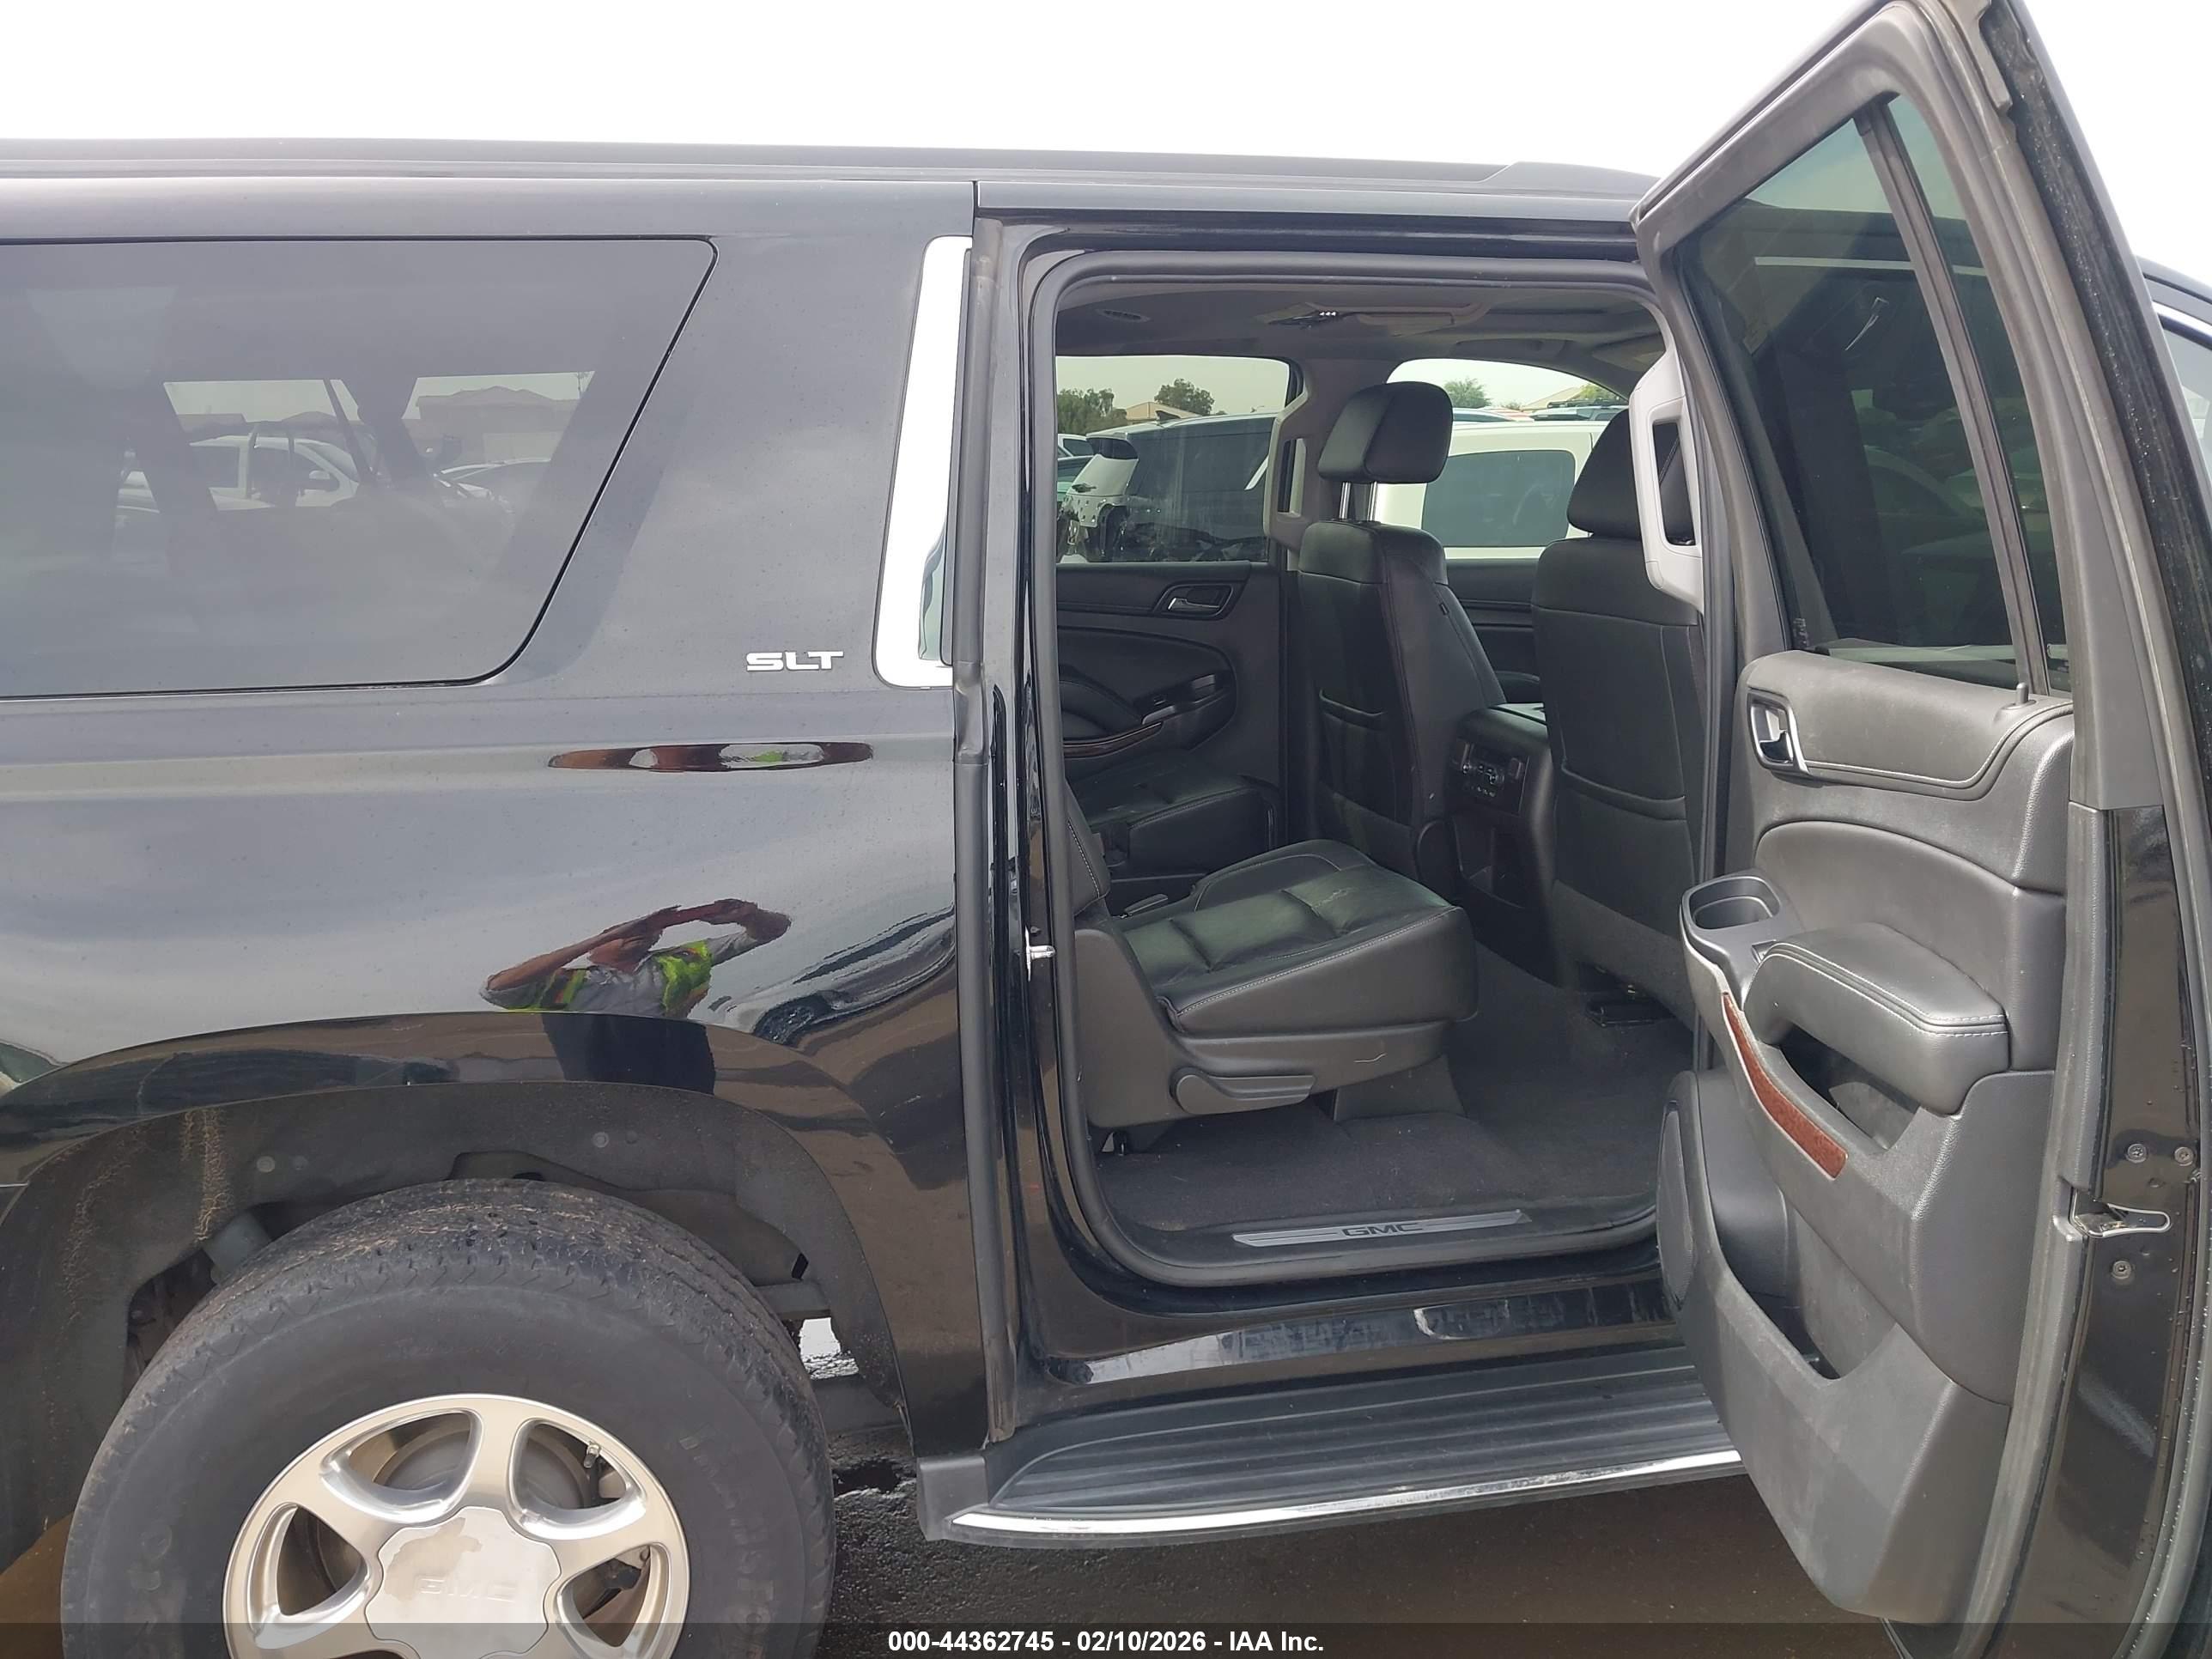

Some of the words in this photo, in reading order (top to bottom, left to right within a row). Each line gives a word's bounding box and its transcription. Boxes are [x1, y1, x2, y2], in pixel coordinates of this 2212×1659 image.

[745, 651, 844, 672] SLT
[1341, 1222, 1425, 1237] GMC
[417, 1575, 516, 1602] GMC
